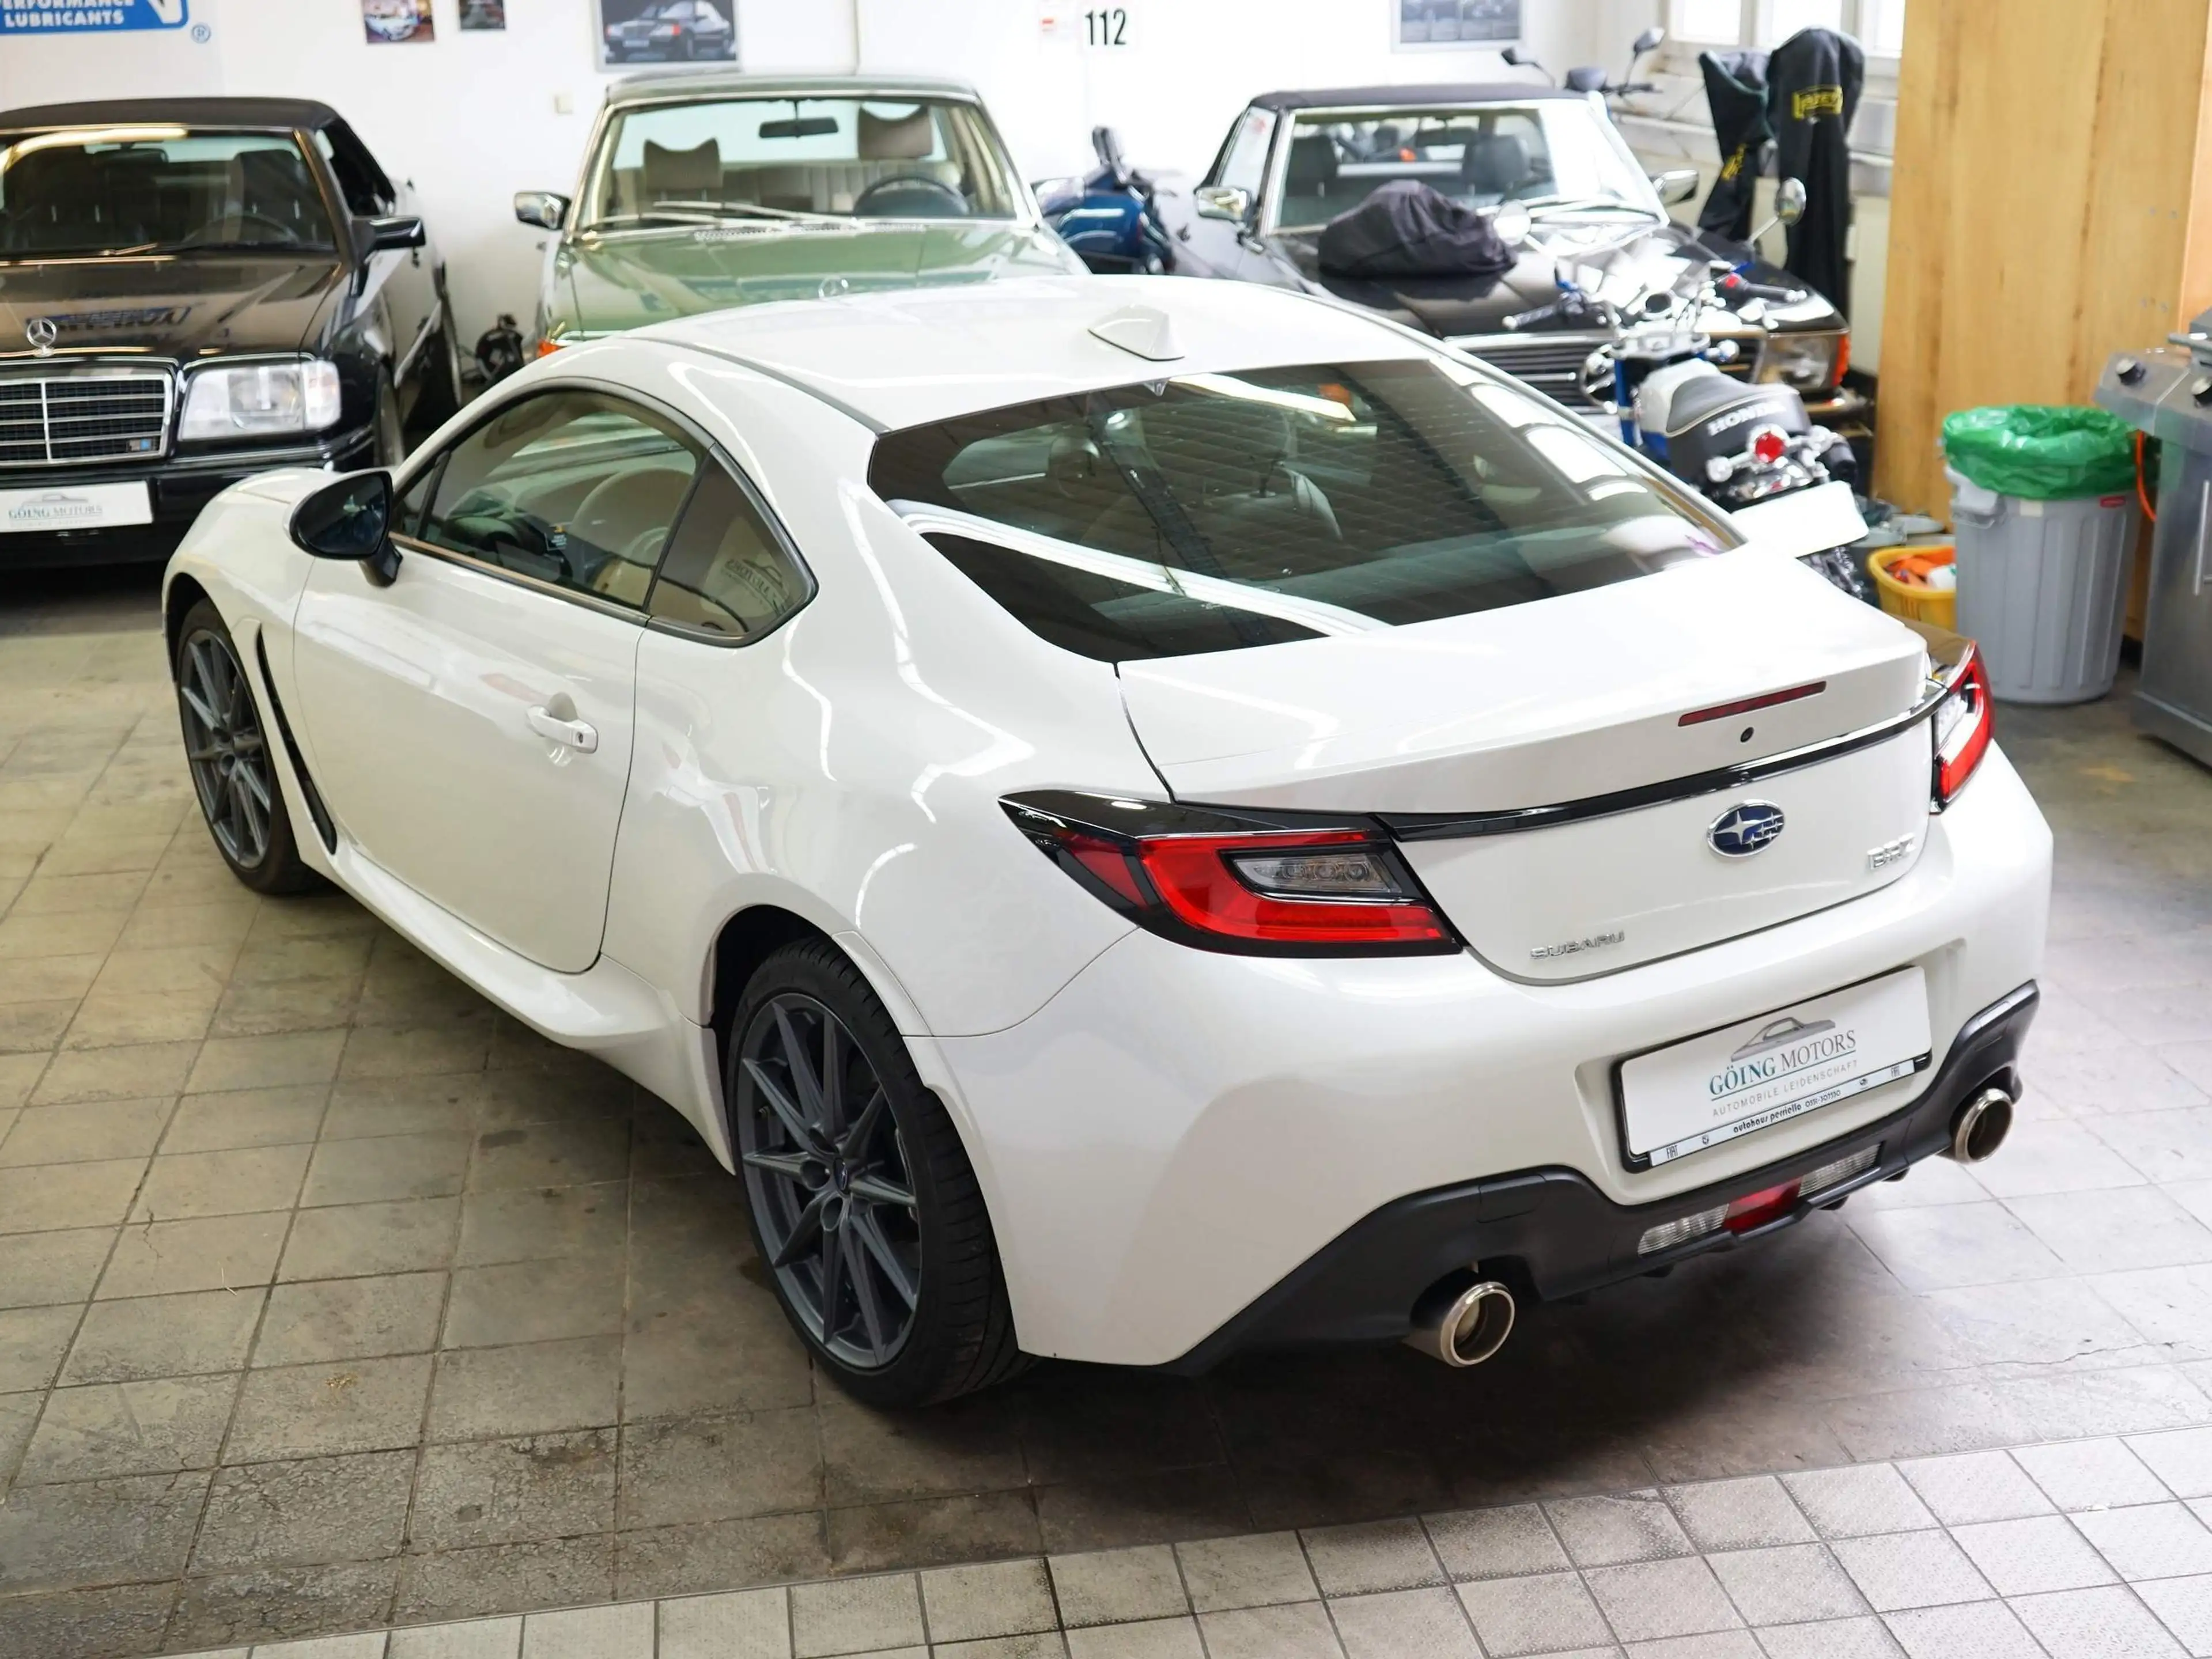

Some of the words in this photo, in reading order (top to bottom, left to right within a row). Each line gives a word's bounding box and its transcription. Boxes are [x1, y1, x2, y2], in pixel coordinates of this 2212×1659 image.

[5, 10, 124, 28] LUBRICANTS
[1084, 8, 1127, 46] 112
[1866, 832, 1916, 870] BRZ
[1530, 929, 1625, 960] SUBARU
[1710, 1057, 1775, 1096] GÖING
[1780, 1030, 1856, 1072] MOTORS
[1712, 1088, 1779, 1118] AUTOMOBILE
[1784, 1059, 1858, 1093] LEIDENSCHAFT
[1733, 1115, 1768, 1133] autohaus
